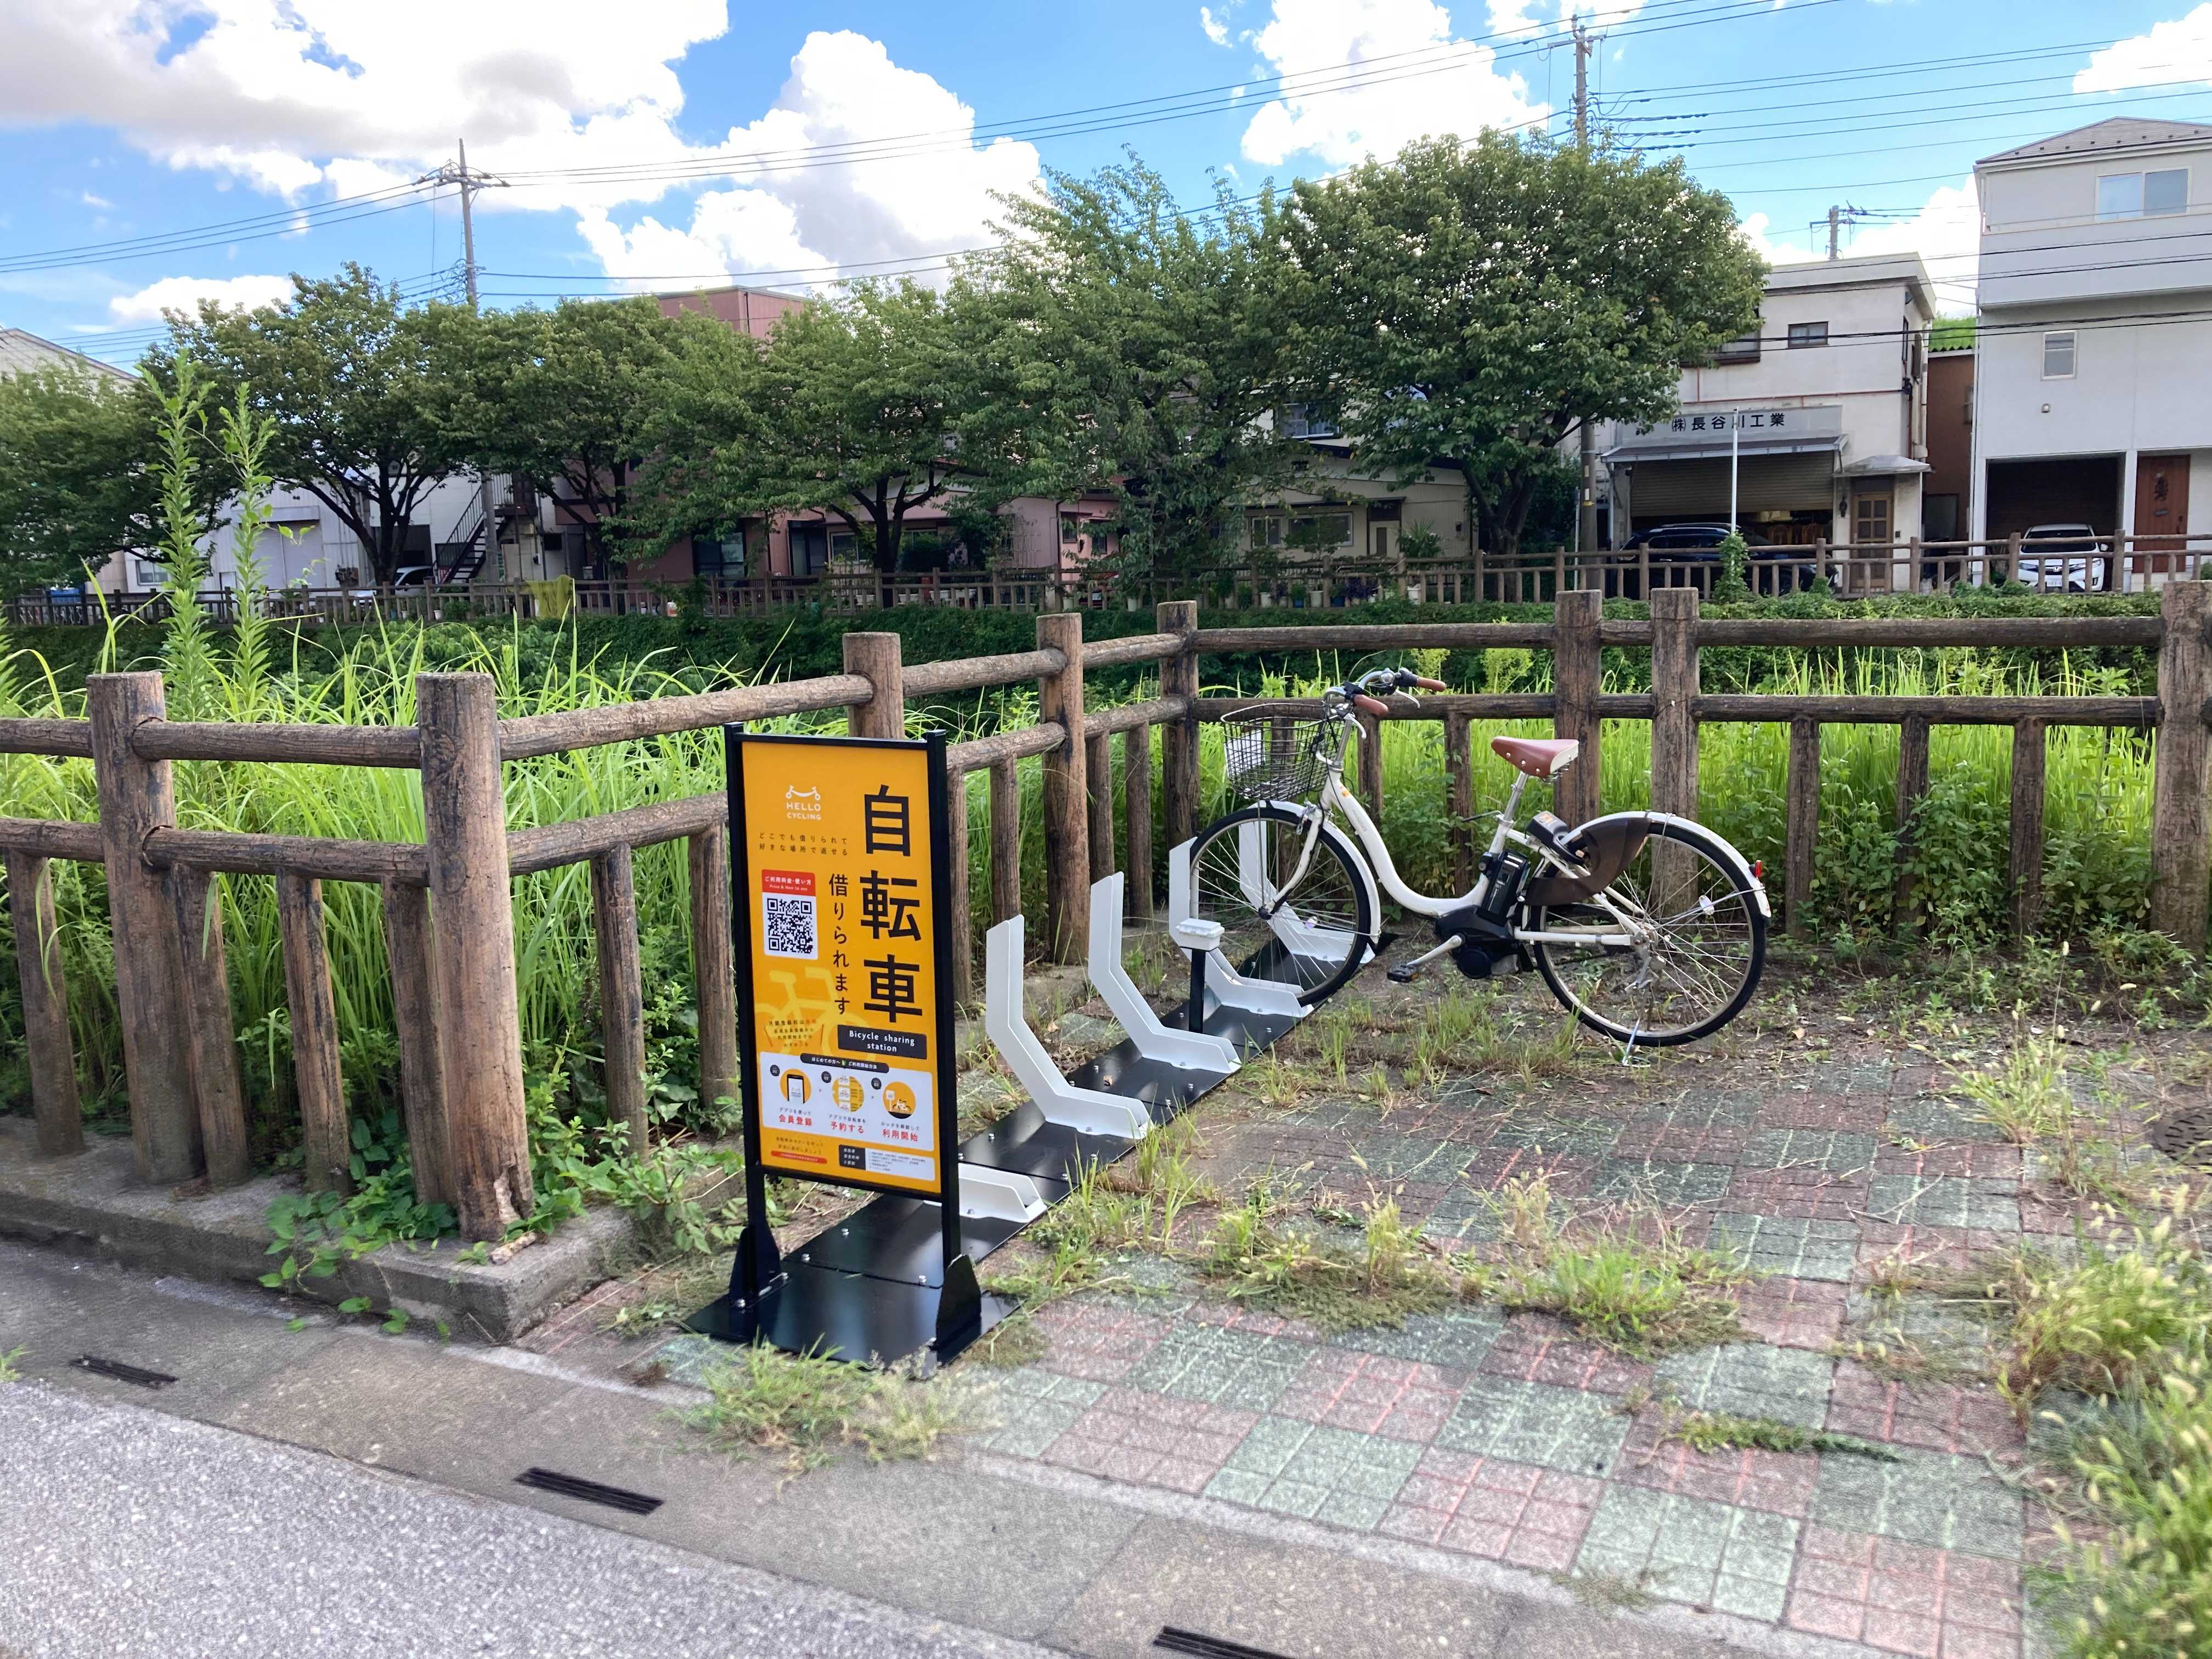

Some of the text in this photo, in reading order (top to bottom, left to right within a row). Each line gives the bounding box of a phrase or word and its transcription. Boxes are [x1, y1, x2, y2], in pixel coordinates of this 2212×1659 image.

[786, 802, 821, 811] HELLO
[787, 812, 822, 821] CYCLING
[759, 832, 847, 845] どこでも借りられて
[759, 843, 848, 856] 好きな場所で返せる
[860, 785, 922, 1023] 自転車
[829, 873, 850, 1015] 借りられます
[849, 1030, 915, 1047] Bicycle sharing
[867, 1043, 898, 1052] station
[811, 1057, 840, 1065] はじめての方へ
[778, 1114, 812, 1127] 会員登録
[830, 1121, 864, 1134] 予約する
[882, 1128, 918, 1142] 利用開始
